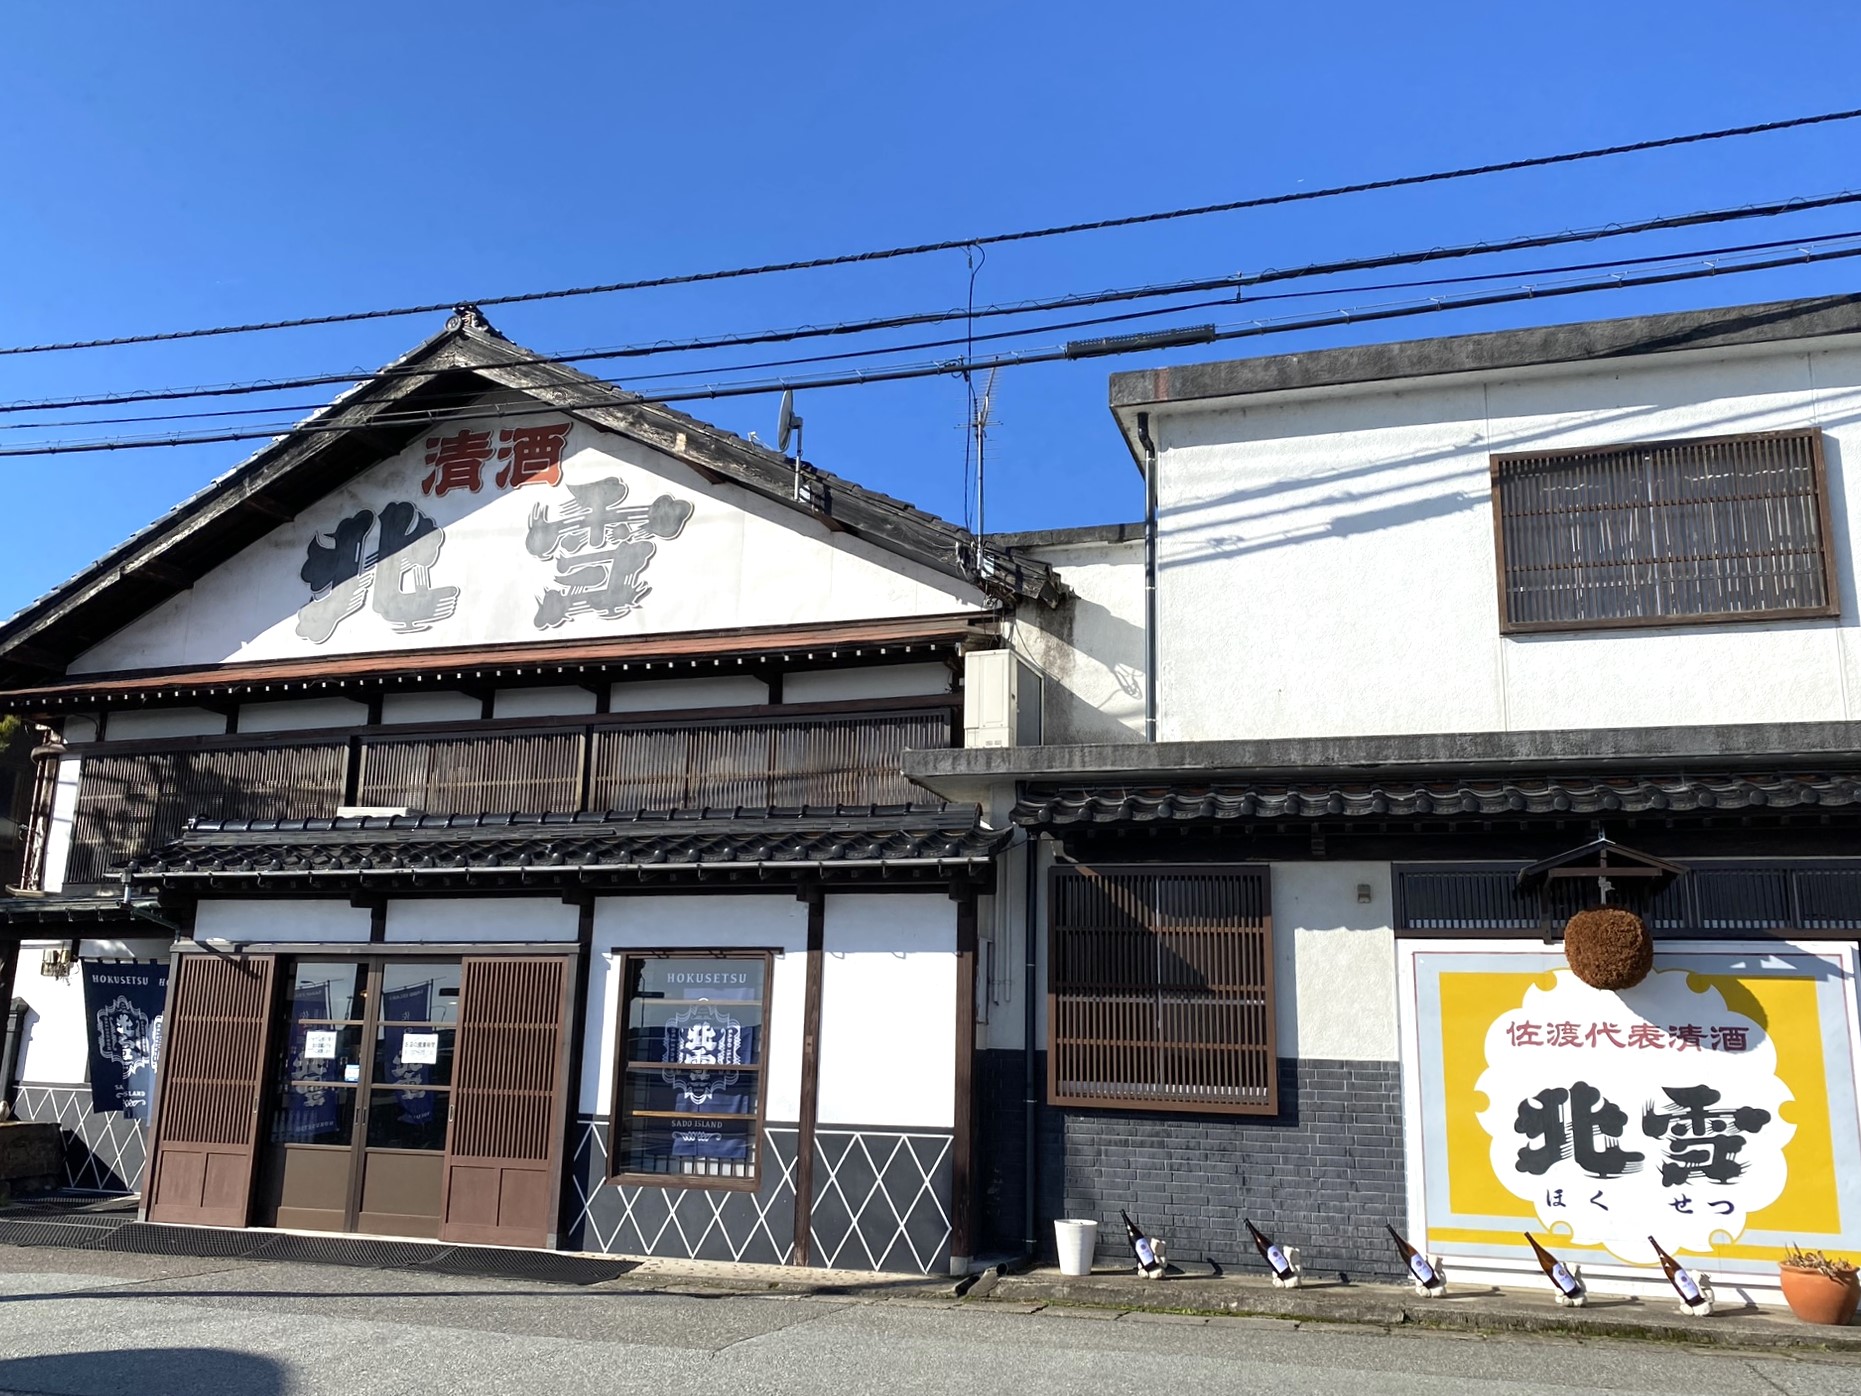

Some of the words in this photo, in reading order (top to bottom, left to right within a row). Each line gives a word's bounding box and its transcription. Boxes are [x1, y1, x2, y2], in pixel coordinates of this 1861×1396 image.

[421, 421, 575, 497] 清酒
[296, 477, 695, 644] 北雪
[92, 974, 149, 986] HOKUSETSU
[667, 972, 748, 984] HOKUSETSU
[1506, 1020, 1750, 1053] 佐渡代表清酒
[671, 1119, 694, 1128] SADO
[694, 1119, 723, 1129] ISLAND
[1514, 1080, 1772, 1188] 北雪
